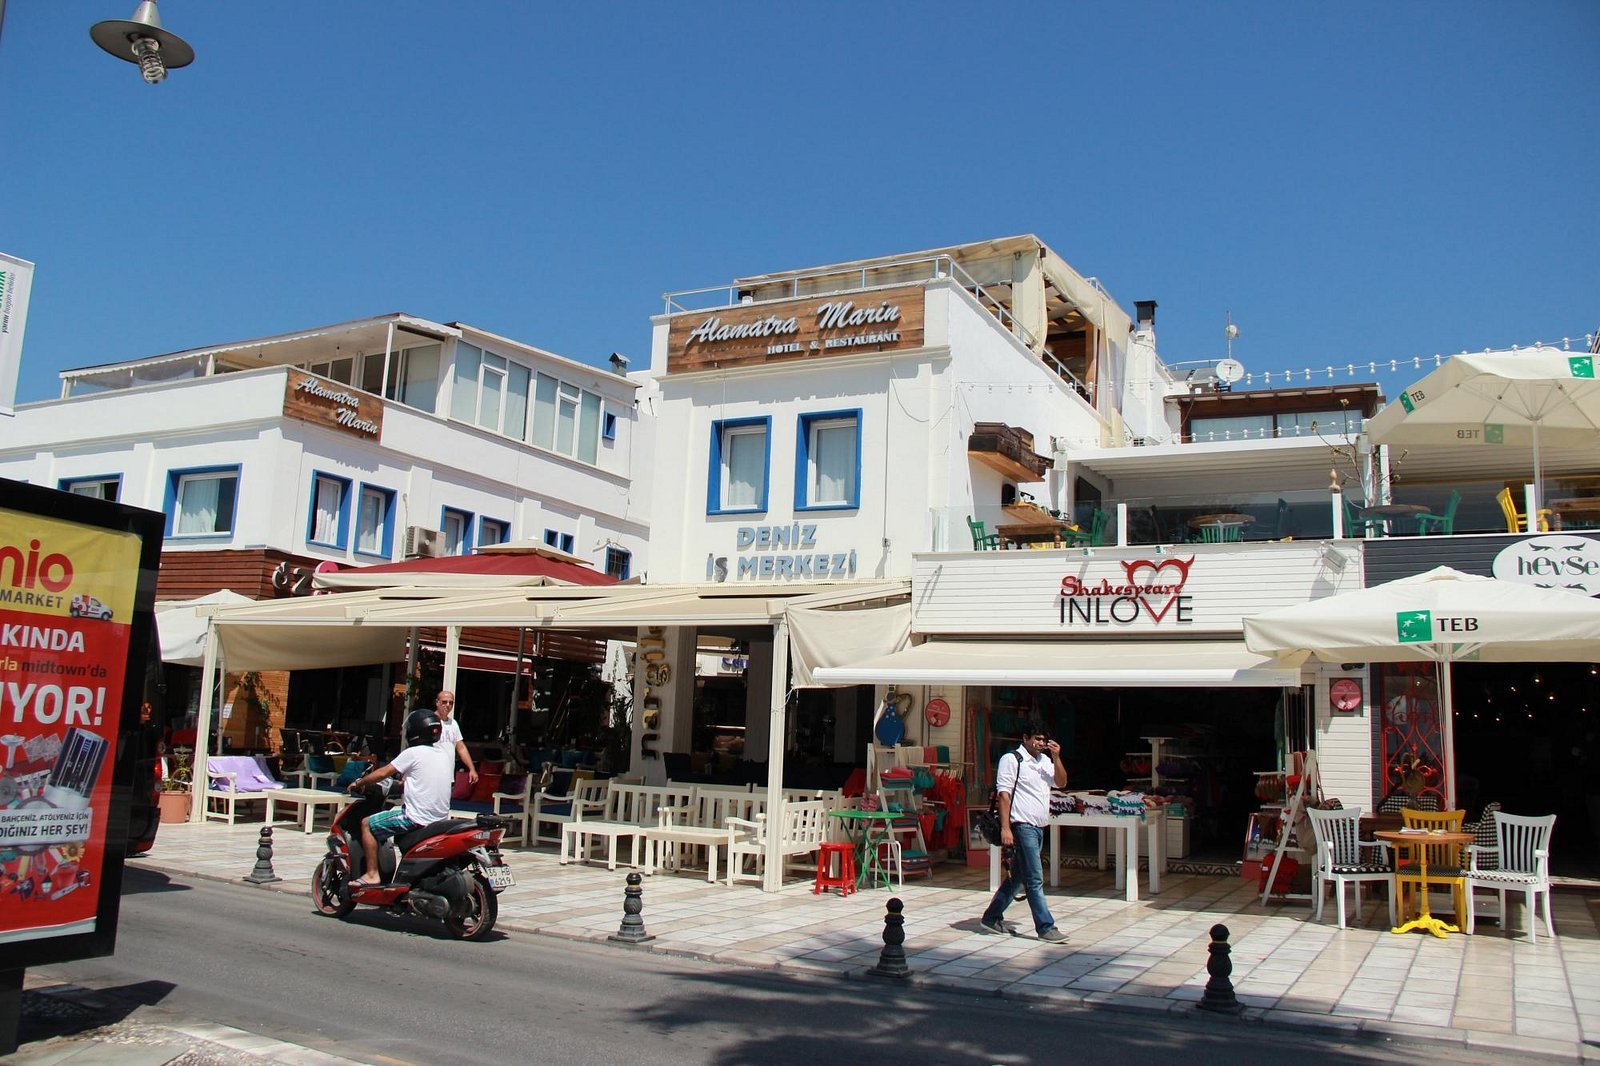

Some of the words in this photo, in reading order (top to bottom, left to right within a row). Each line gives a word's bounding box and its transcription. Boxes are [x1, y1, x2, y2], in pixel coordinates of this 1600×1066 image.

[686, 314, 798, 345] Alamatra
[817, 301, 901, 329] Marin
[767, 342, 801, 354] HOTEL
[809, 340, 819, 350] &
[826, 332, 901, 348] RESTAURANT
[296, 377, 361, 407] Alamatra
[1411, 390, 1426, 403] TEB
[336, 408, 378, 434] Marin
[737, 521, 817, 549] DENİZ
[738, 549, 857, 580] MERKEZİ
[0, 589, 63, 609] MARKET
[1061, 576, 1182, 602] Shakespeare
[1060, 595, 1193, 624] INLOVE
[1436, 617, 1479, 632] TEB
[2, 623, 85, 653] KINDA
[22, 660, 107, 678] midtown'da
[41, 825, 63, 836] HER
[65, 823, 88, 837] ŞEY!
